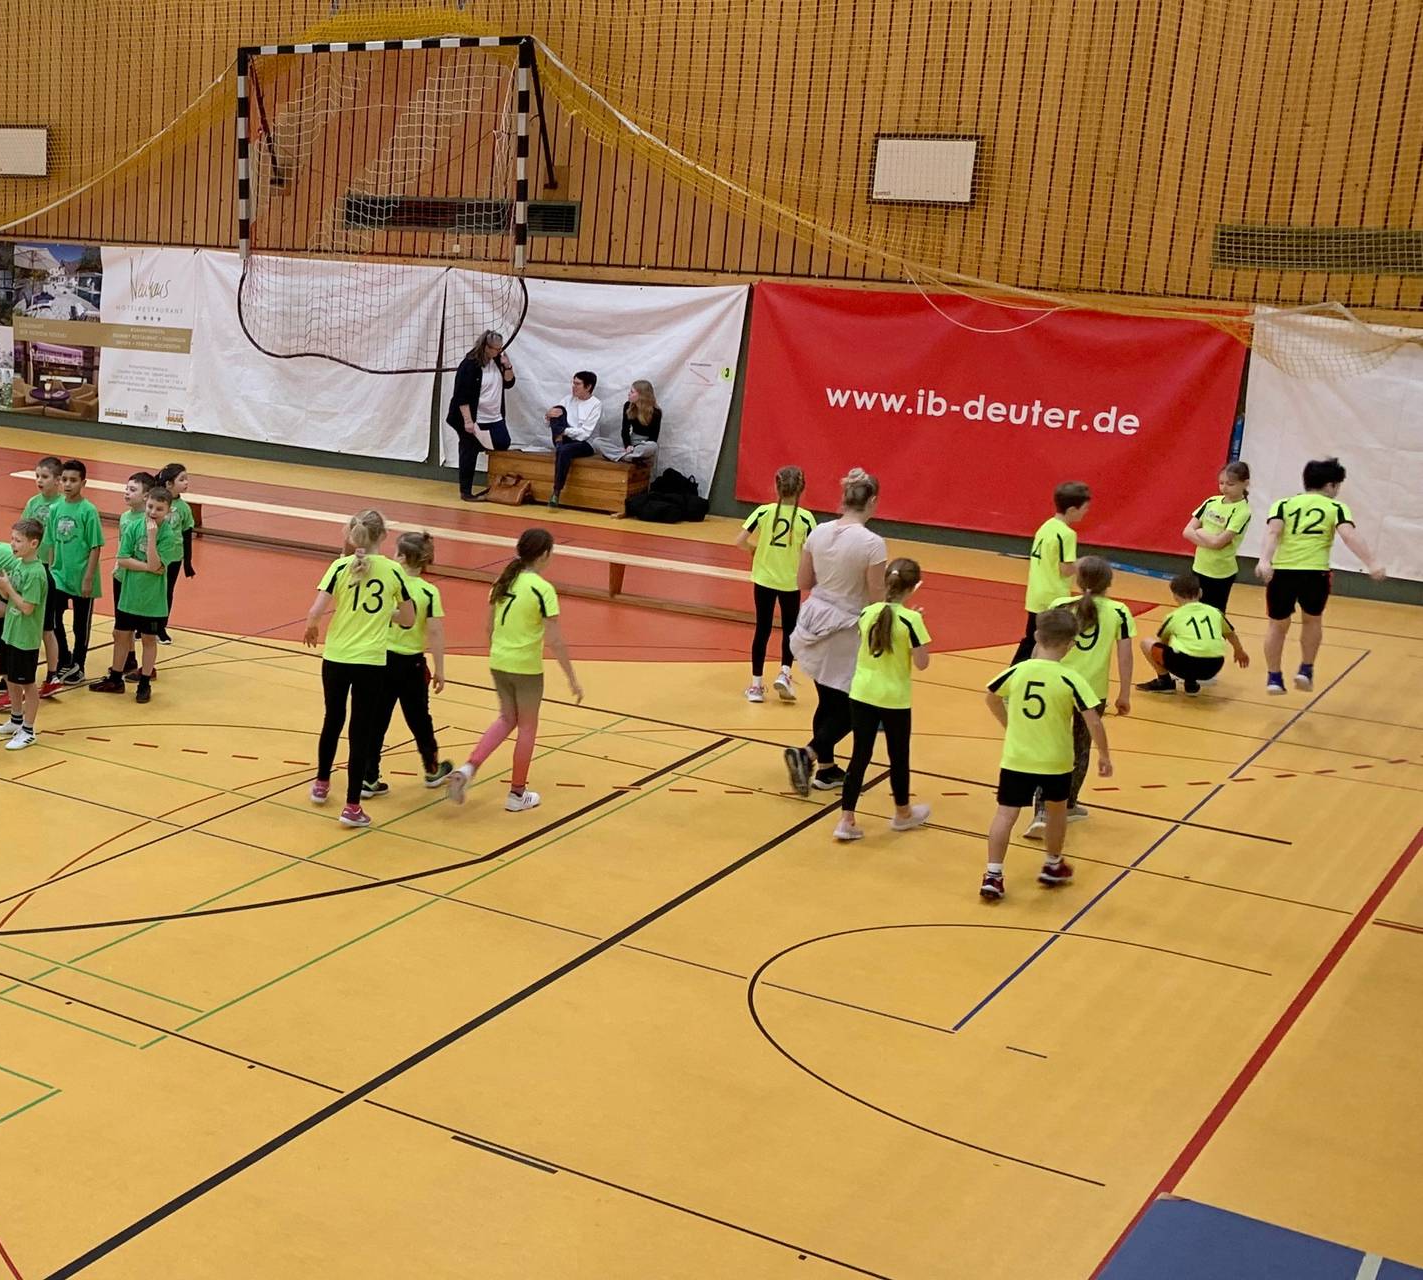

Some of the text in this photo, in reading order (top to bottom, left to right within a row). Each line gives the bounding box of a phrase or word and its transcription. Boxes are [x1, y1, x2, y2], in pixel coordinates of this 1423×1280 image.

[826, 387, 1141, 436] www.ib-deuter.de
[769, 518, 790, 548] 2
[1288, 508, 1326, 535] 12
[1031, 537, 1044, 563] 4
[348, 578, 384, 614] 13
[498, 592, 517, 626] 7
[1186, 615, 1215, 640] 11
[1022, 681, 1046, 720] 5
